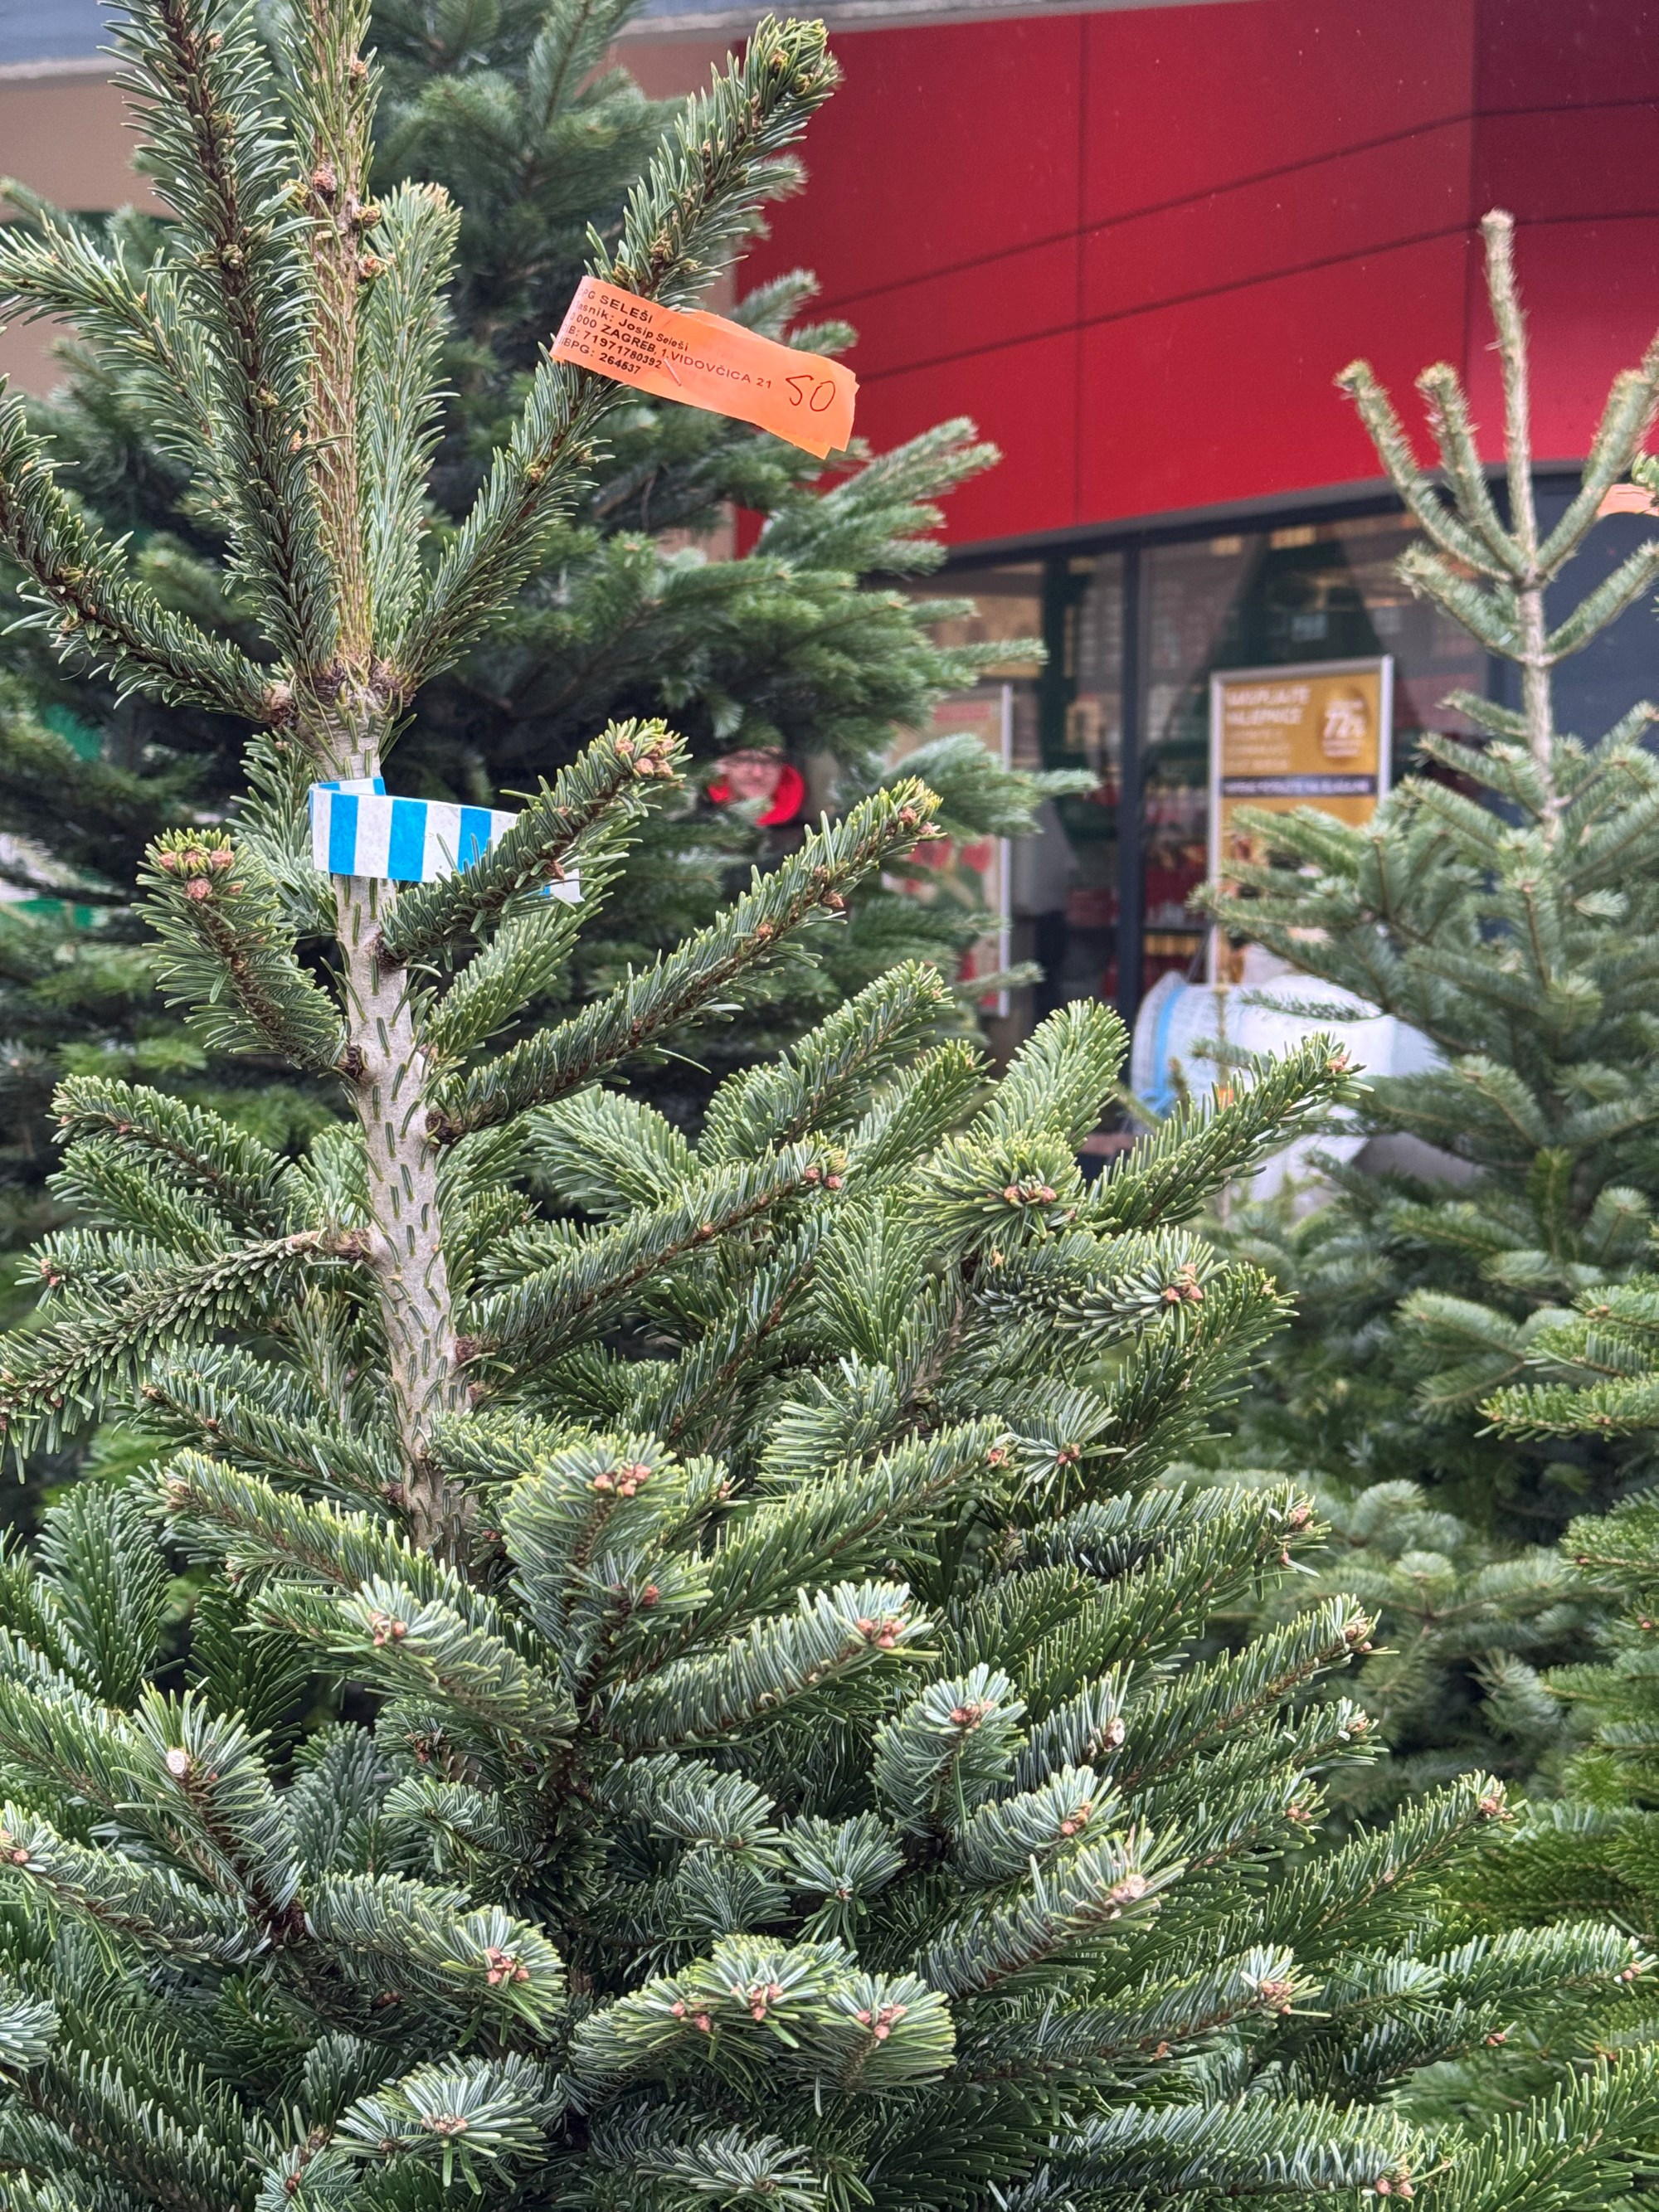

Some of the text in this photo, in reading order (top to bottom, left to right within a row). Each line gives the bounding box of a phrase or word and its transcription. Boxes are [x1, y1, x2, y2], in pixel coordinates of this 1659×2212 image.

[574, 299, 689, 352] lasnik: Josip Seleši
[600, 294, 654, 324] SELEŠI
[582, 331, 663, 369] 71971780392
[601, 323, 657, 356] ZAGREB,
[756, 377, 771, 389] 21
